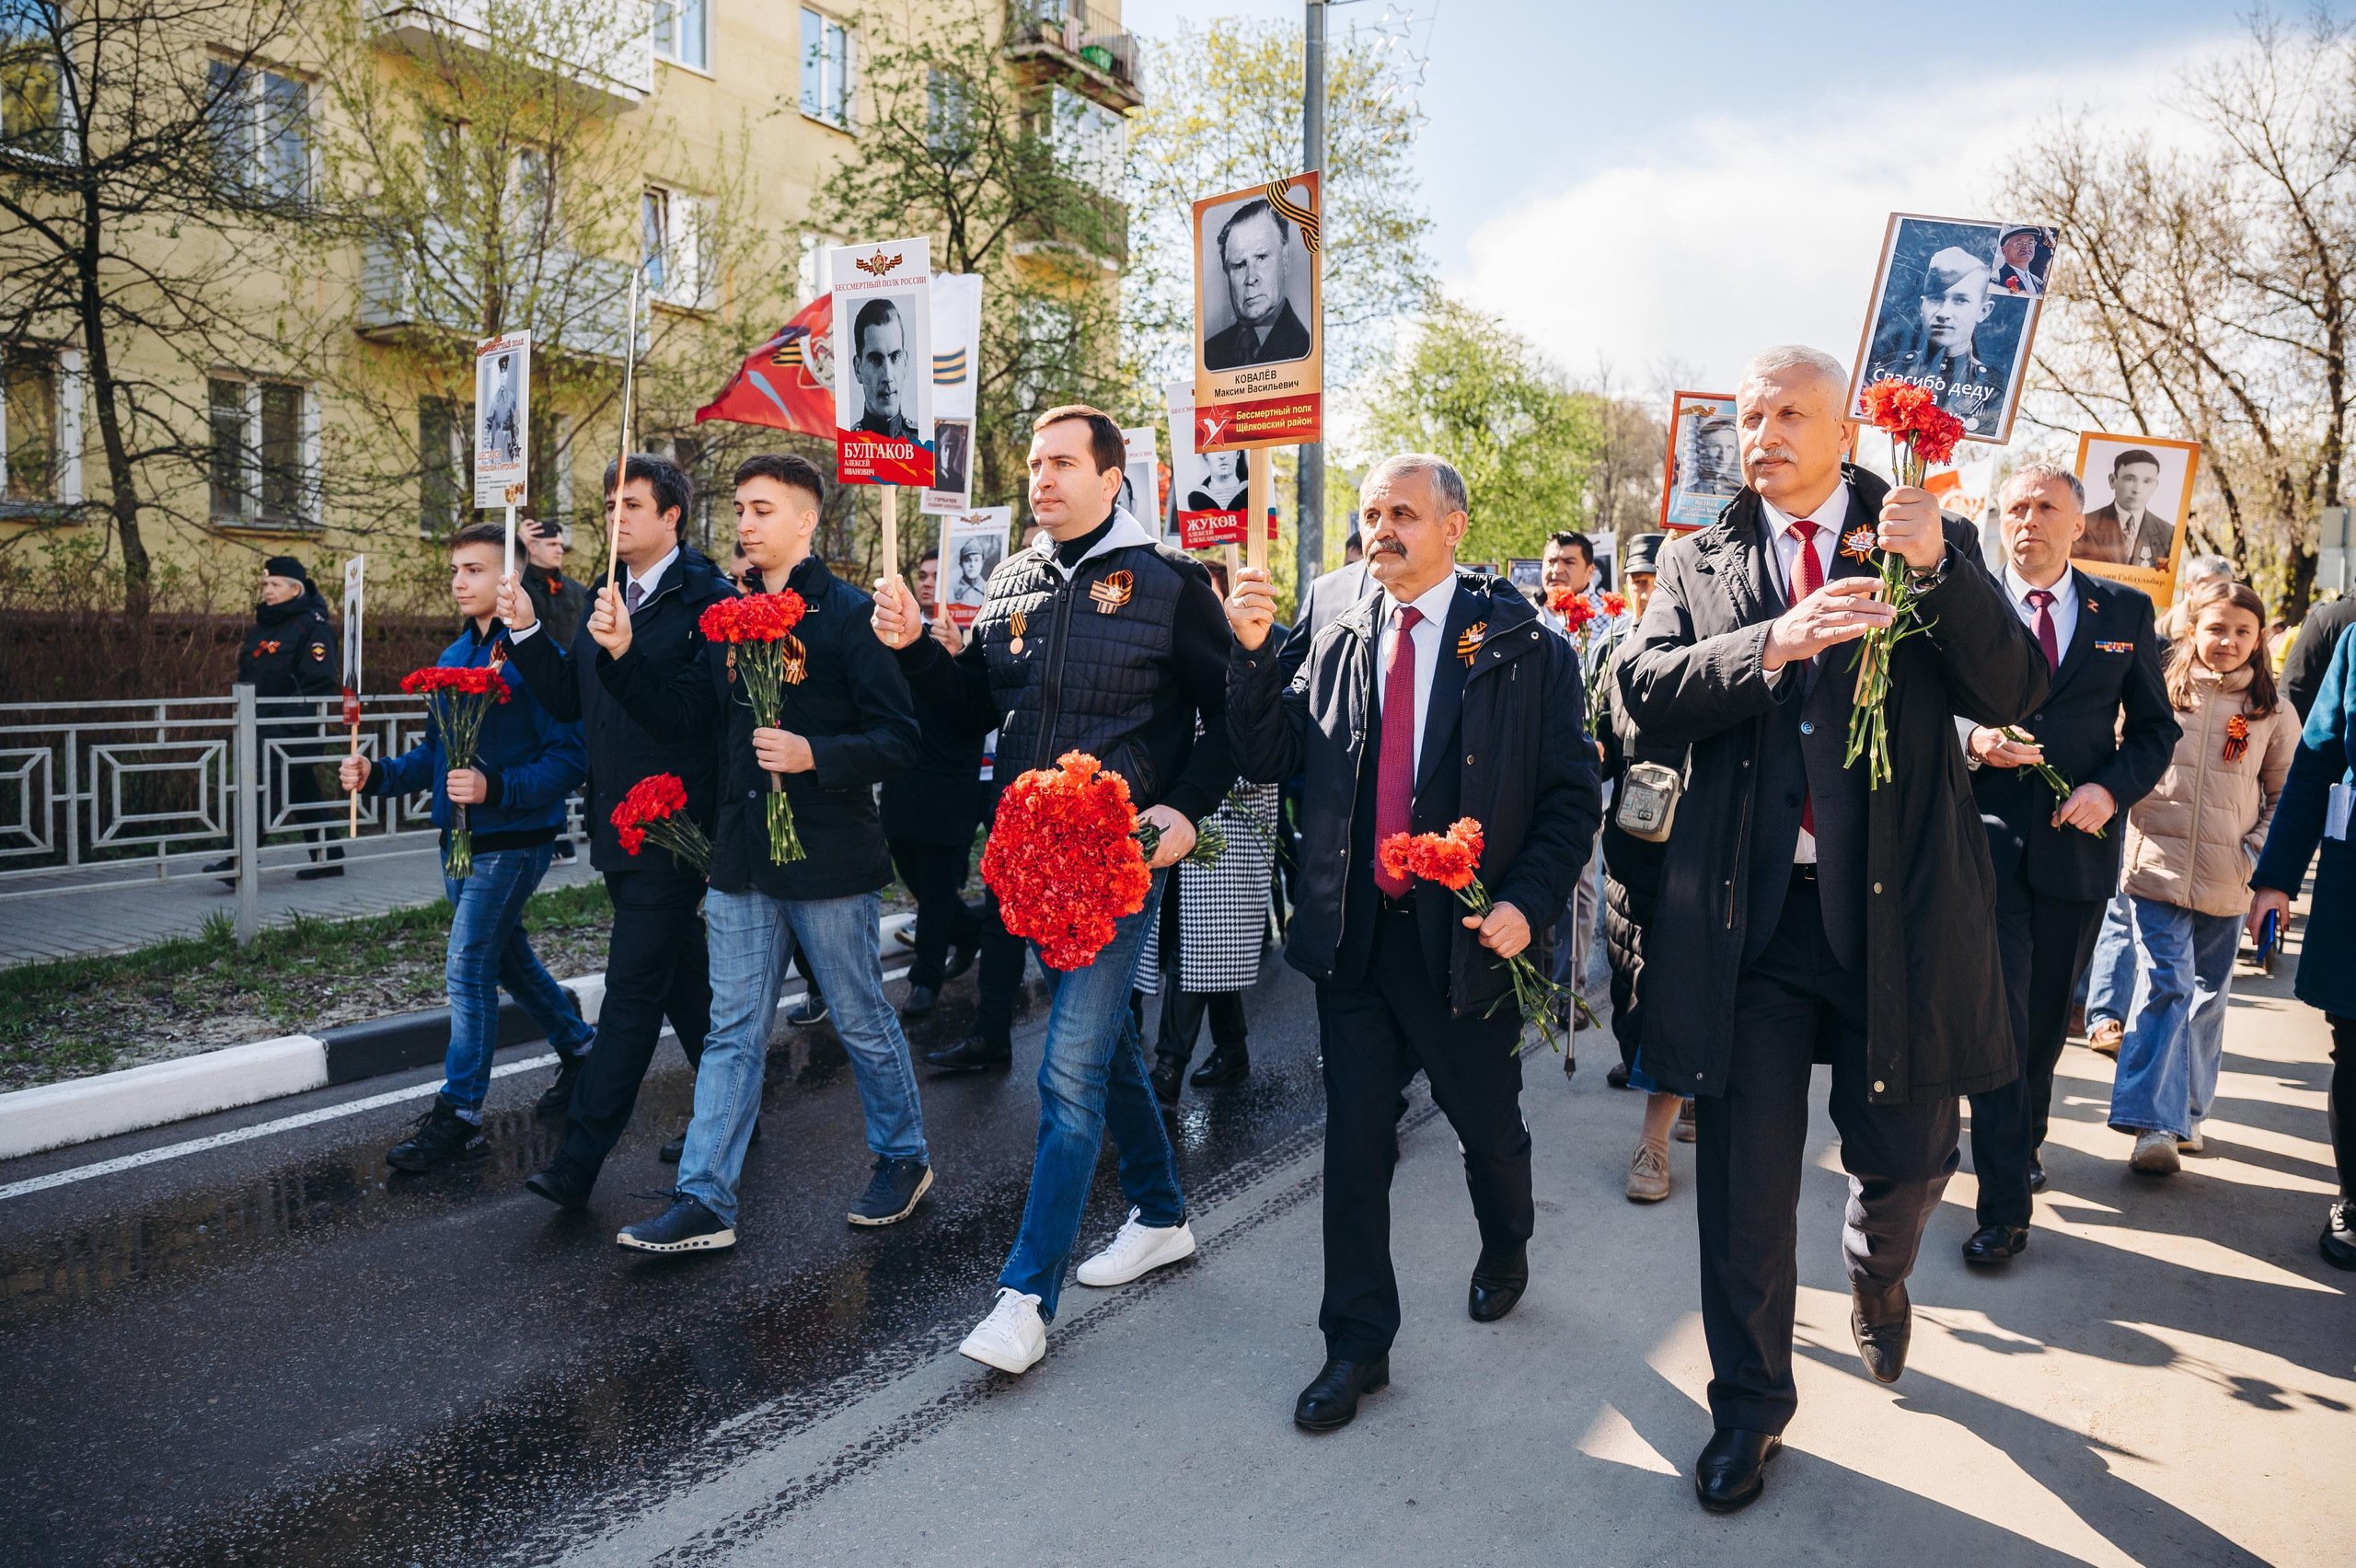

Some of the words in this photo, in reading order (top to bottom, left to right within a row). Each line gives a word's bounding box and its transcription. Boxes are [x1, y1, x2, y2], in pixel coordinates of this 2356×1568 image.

[835, 279, 881, 292] БЕССМЕРТНЫЙ
[882, 278, 899, 288] ПОЛК
[900, 276, 927, 286] РОССИИ
[1235, 369, 1277, 385] КОВАЛЁВ
[1873, 368, 1946, 391] Спасибо
[1948, 382, 1995, 402] деду
[1214, 386, 1245, 398] Максим
[1247, 380, 1299, 394] Васильевич
[1236, 406, 1290, 421] Бессмертный
[1292, 405, 1312, 414] полк
[1235, 419, 1286, 433] Щёлковский
[1287, 417, 1312, 429] район
[844, 443, 915, 459] БУЛГАКОВ
[844, 459, 871, 467] АЛЕКСЕЙ
[844, 467, 875, 476] ИВАНОВИЧ
[1186, 514, 1238, 532] ЖУКОВ
[1187, 529, 1215, 537] АЛЕКСЕЙ
[1187, 533, 1237, 544] АЛЕКСАНДРОВИЧ
[2118, 573, 2165, 588] Габдульбар
